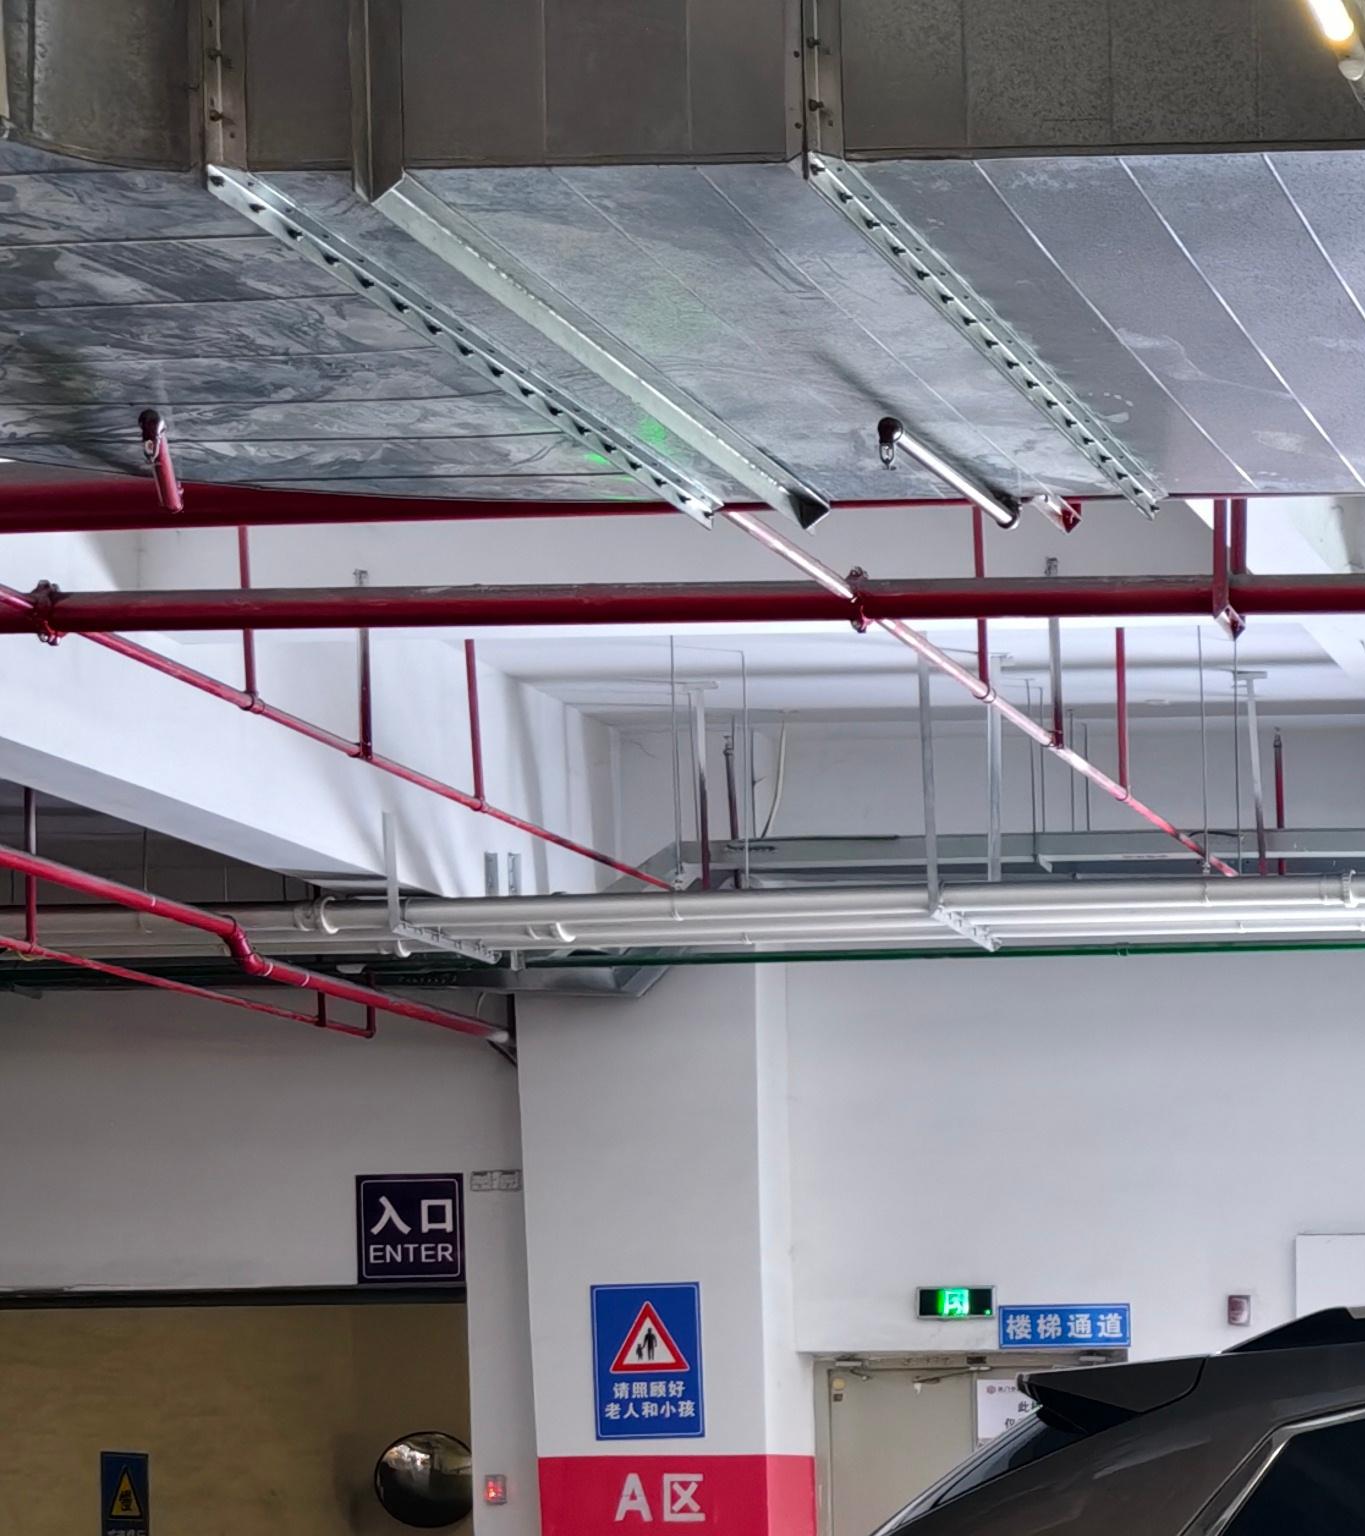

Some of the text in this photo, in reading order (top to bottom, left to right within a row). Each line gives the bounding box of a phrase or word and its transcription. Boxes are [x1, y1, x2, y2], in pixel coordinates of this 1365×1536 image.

[370, 1195, 454, 1236] 入口
[369, 1243, 454, 1264] ENTER
[1006, 1313, 1124, 1340] 楼梯通道
[613, 1381, 686, 1400] 请照顾好
[605, 1400, 696, 1420] 老人和小孩
[614, 1472, 706, 1522] A区
